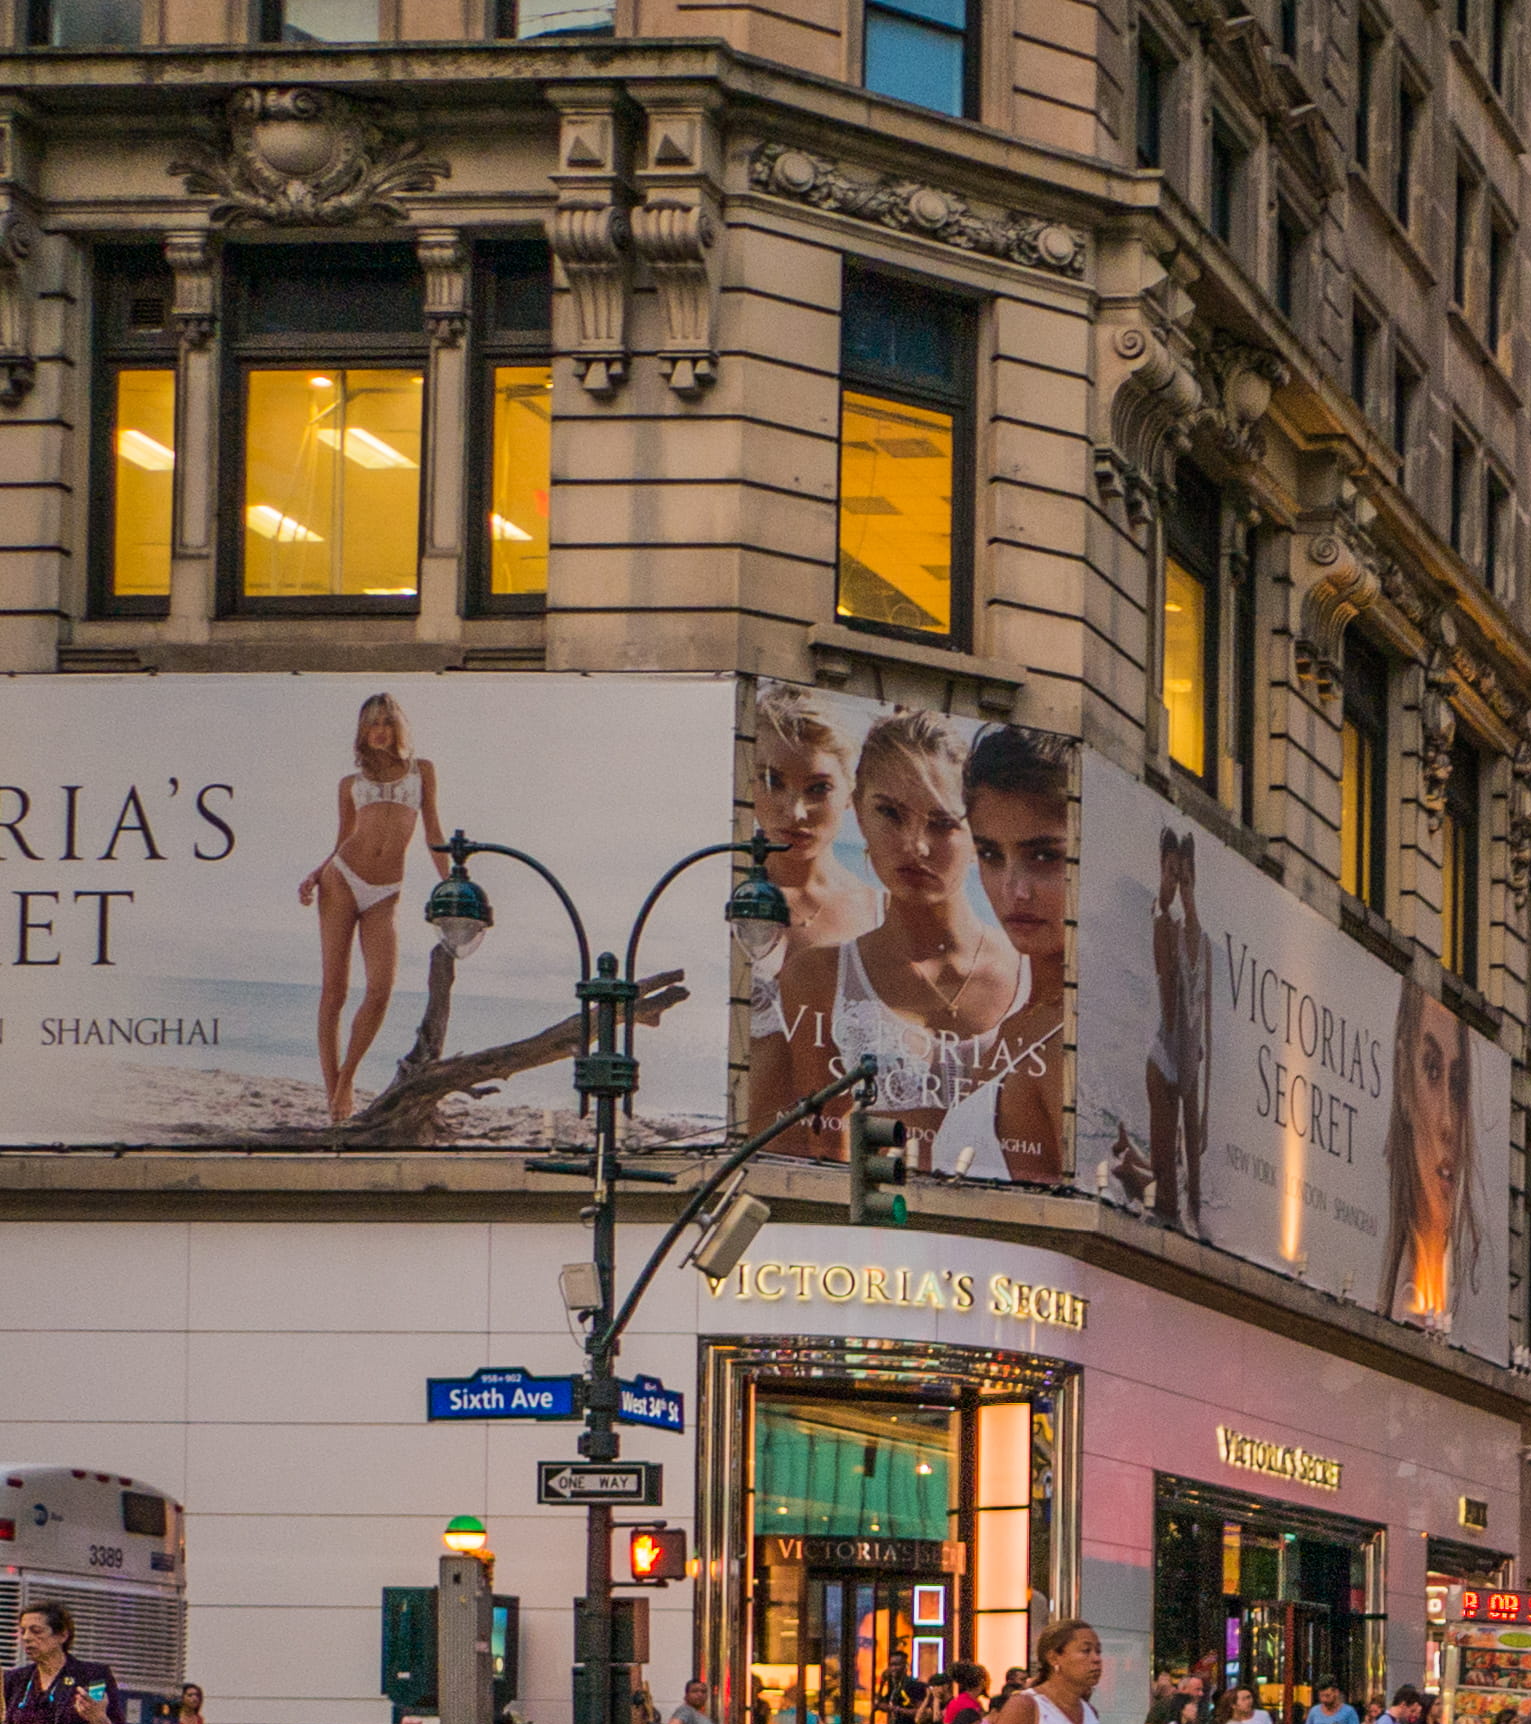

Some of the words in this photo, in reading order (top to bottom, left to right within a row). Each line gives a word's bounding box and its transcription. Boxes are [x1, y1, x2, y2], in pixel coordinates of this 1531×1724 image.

[12, 890, 134, 965] ET
[41, 1017, 219, 1045] SHANGHAI
[774, 1001, 1047, 1077] VICTORIA'S
[1225, 931, 1381, 1098] VICTORIA'S
[828, 1056, 1005, 1110] SCRET
[1257, 1045, 1358, 1164] SECRET
[991, 1273, 1091, 1330] SECRET
[450, 1388, 504, 1411] Sixth
[511, 1388, 553, 1410] Ave
[622, 1391, 648, 1416] West
[668, 1403, 680, 1423] St
[559, 1476, 585, 1489] ONE
[600, 1476, 629, 1489] WAY
[90, 1544, 123, 1568] 3389
